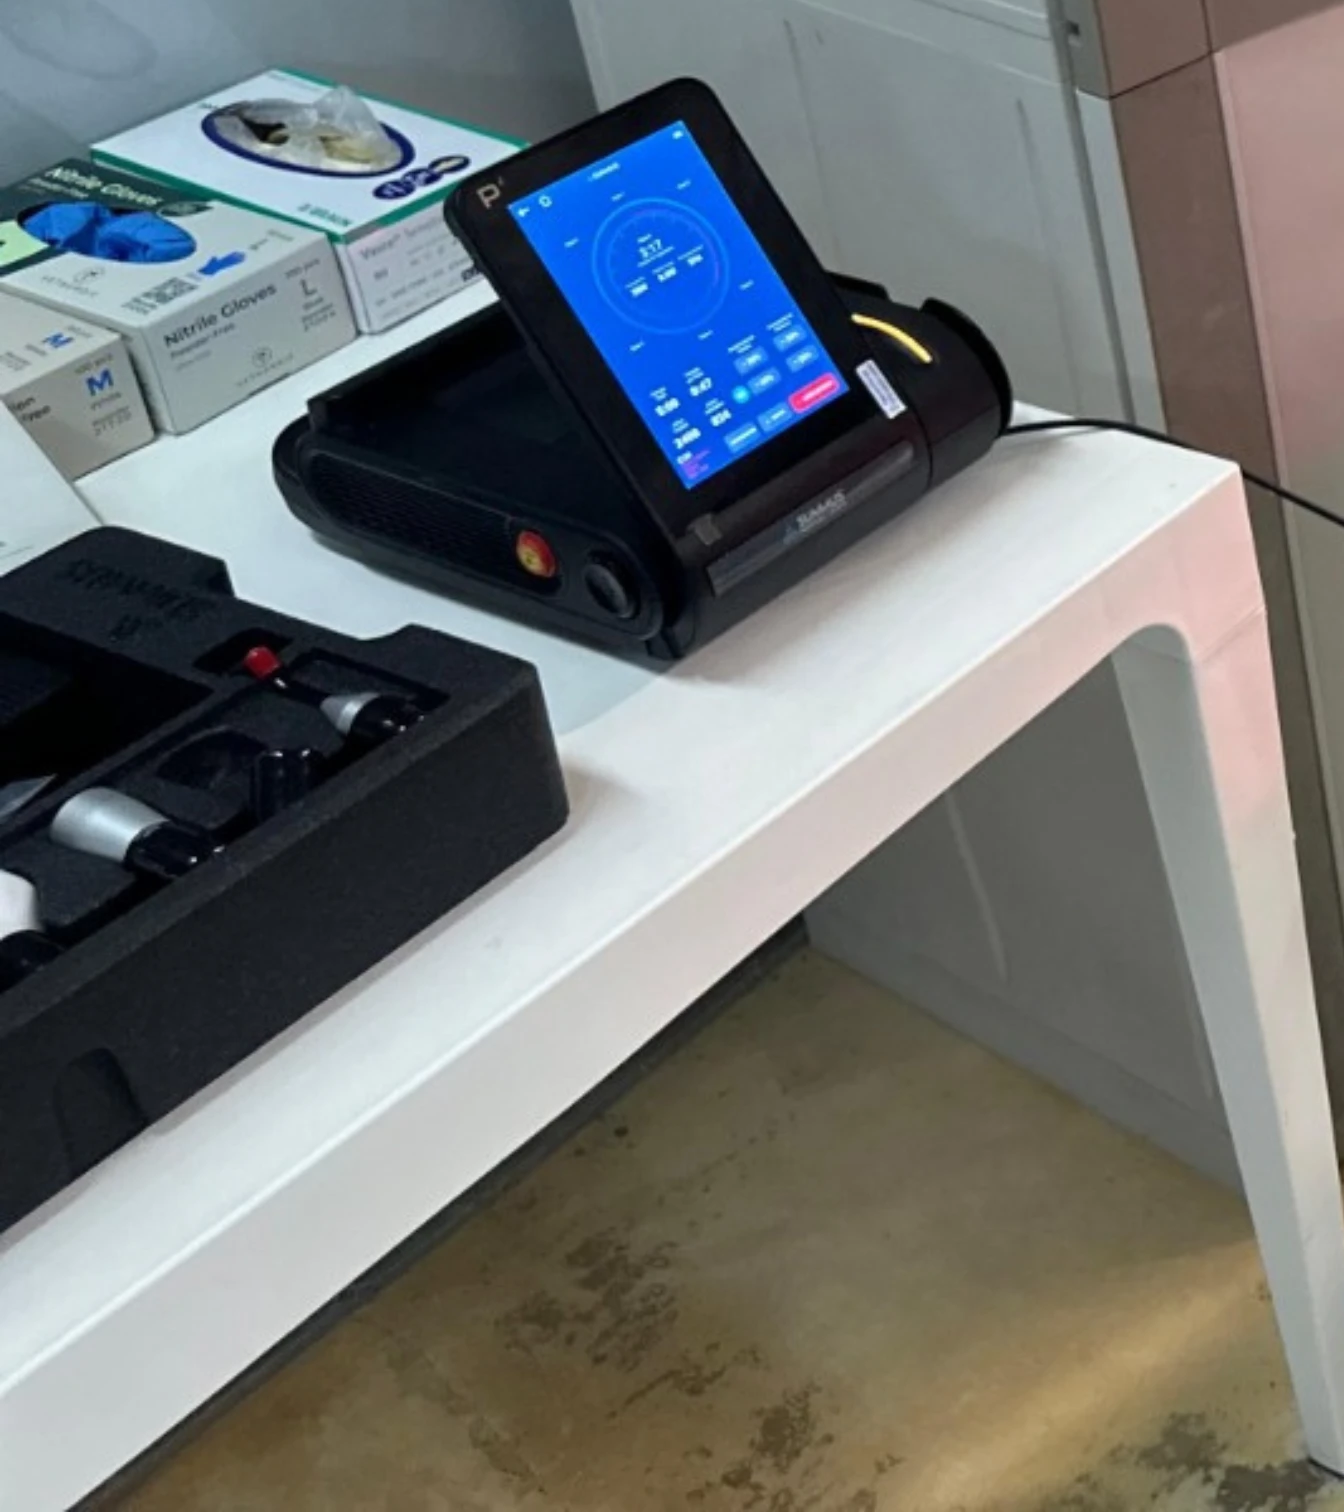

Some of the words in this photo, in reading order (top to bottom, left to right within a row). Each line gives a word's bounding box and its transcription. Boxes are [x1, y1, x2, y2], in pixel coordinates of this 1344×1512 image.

[301, 279, 317, 296] L
[163, 313, 218, 348] Nitrile
[220, 284, 278, 319] Gloves
[86, 366, 114, 396] M
